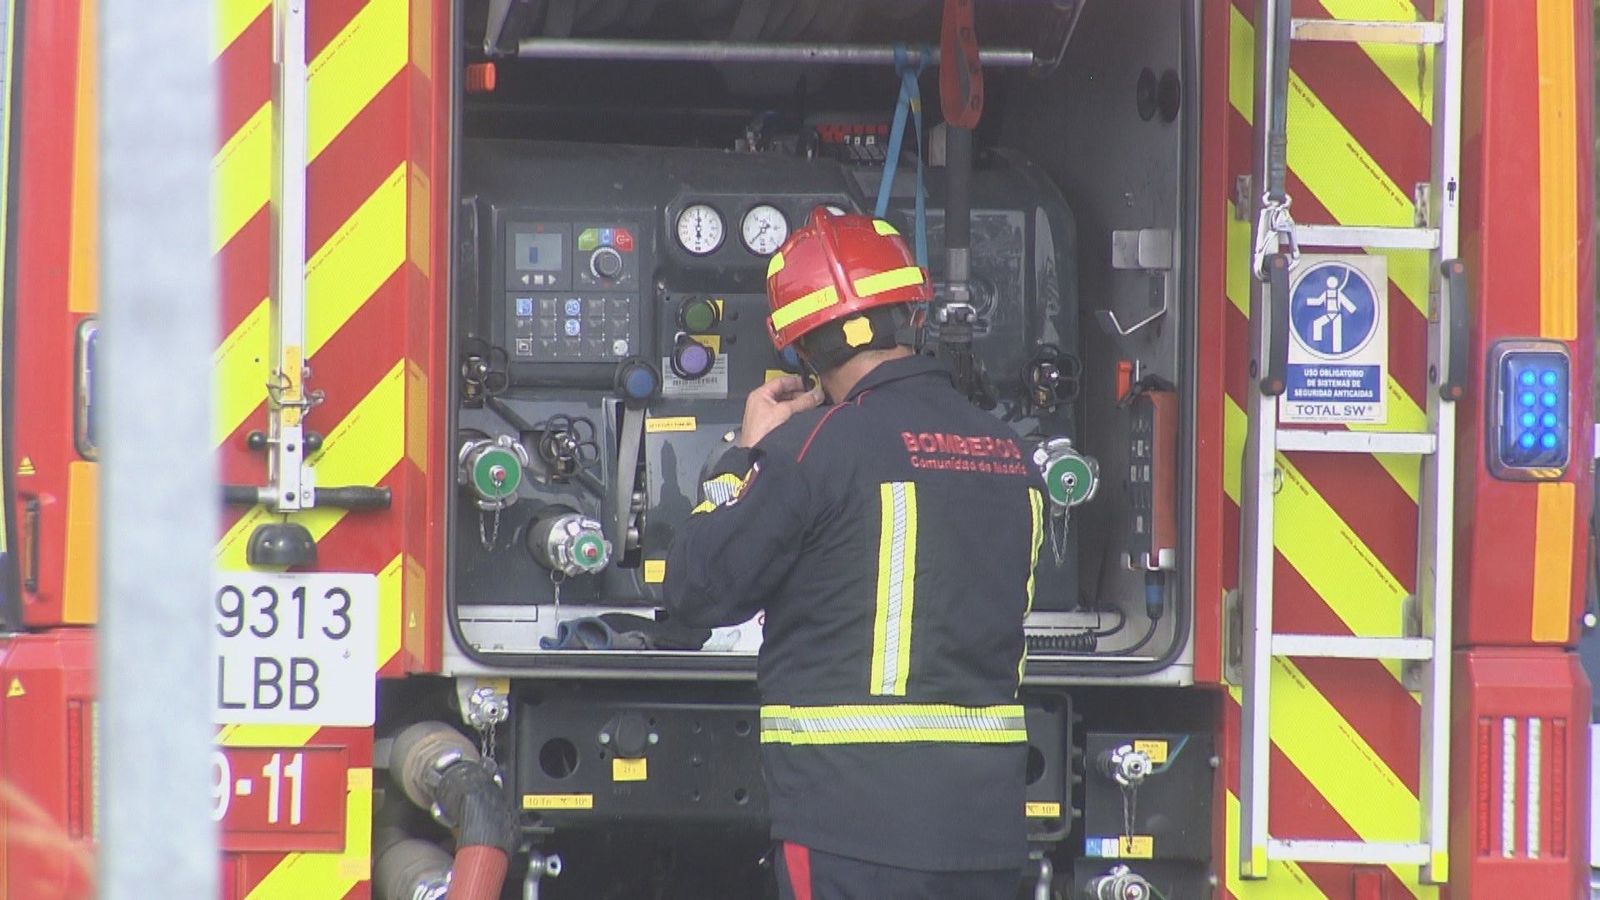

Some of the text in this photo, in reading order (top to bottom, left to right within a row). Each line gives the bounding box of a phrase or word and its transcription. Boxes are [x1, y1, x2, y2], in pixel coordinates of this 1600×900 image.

[1303, 368, 1364, 378] USO OBLIGATORIO
[1306, 379, 1361, 388] DE SISTEMAS DE
[1294, 388, 1332, 397] SEGURIDAD
[1295, 404, 1341, 416] TOTAL
[978, 461, 992, 473] de
[215, 584, 352, 640] 9313
[217, 655, 320, 711] LBB
